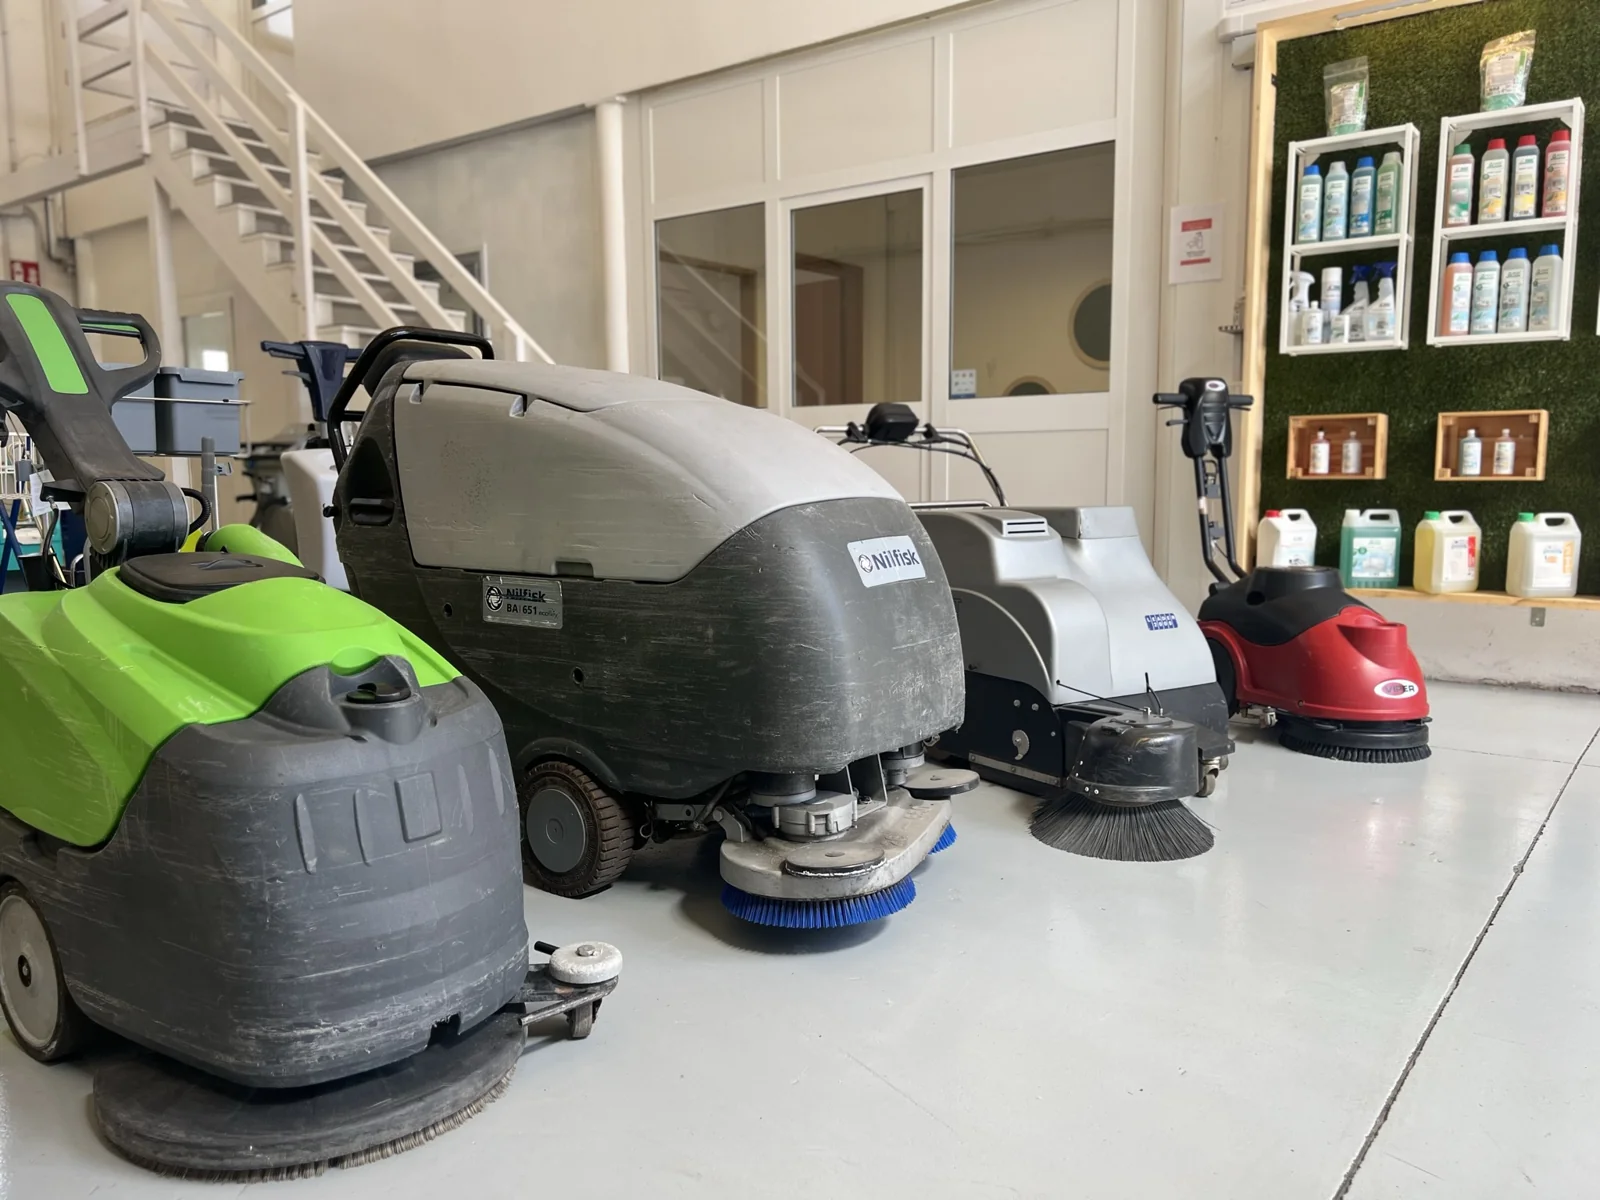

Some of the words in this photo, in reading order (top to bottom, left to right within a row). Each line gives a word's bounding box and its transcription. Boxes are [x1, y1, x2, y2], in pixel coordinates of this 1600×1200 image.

[871, 549, 920, 570] Nilfisk
[506, 588, 546, 602] Nilfisk
[506, 603, 519, 613] BA
[522, 605, 537, 615] 651
